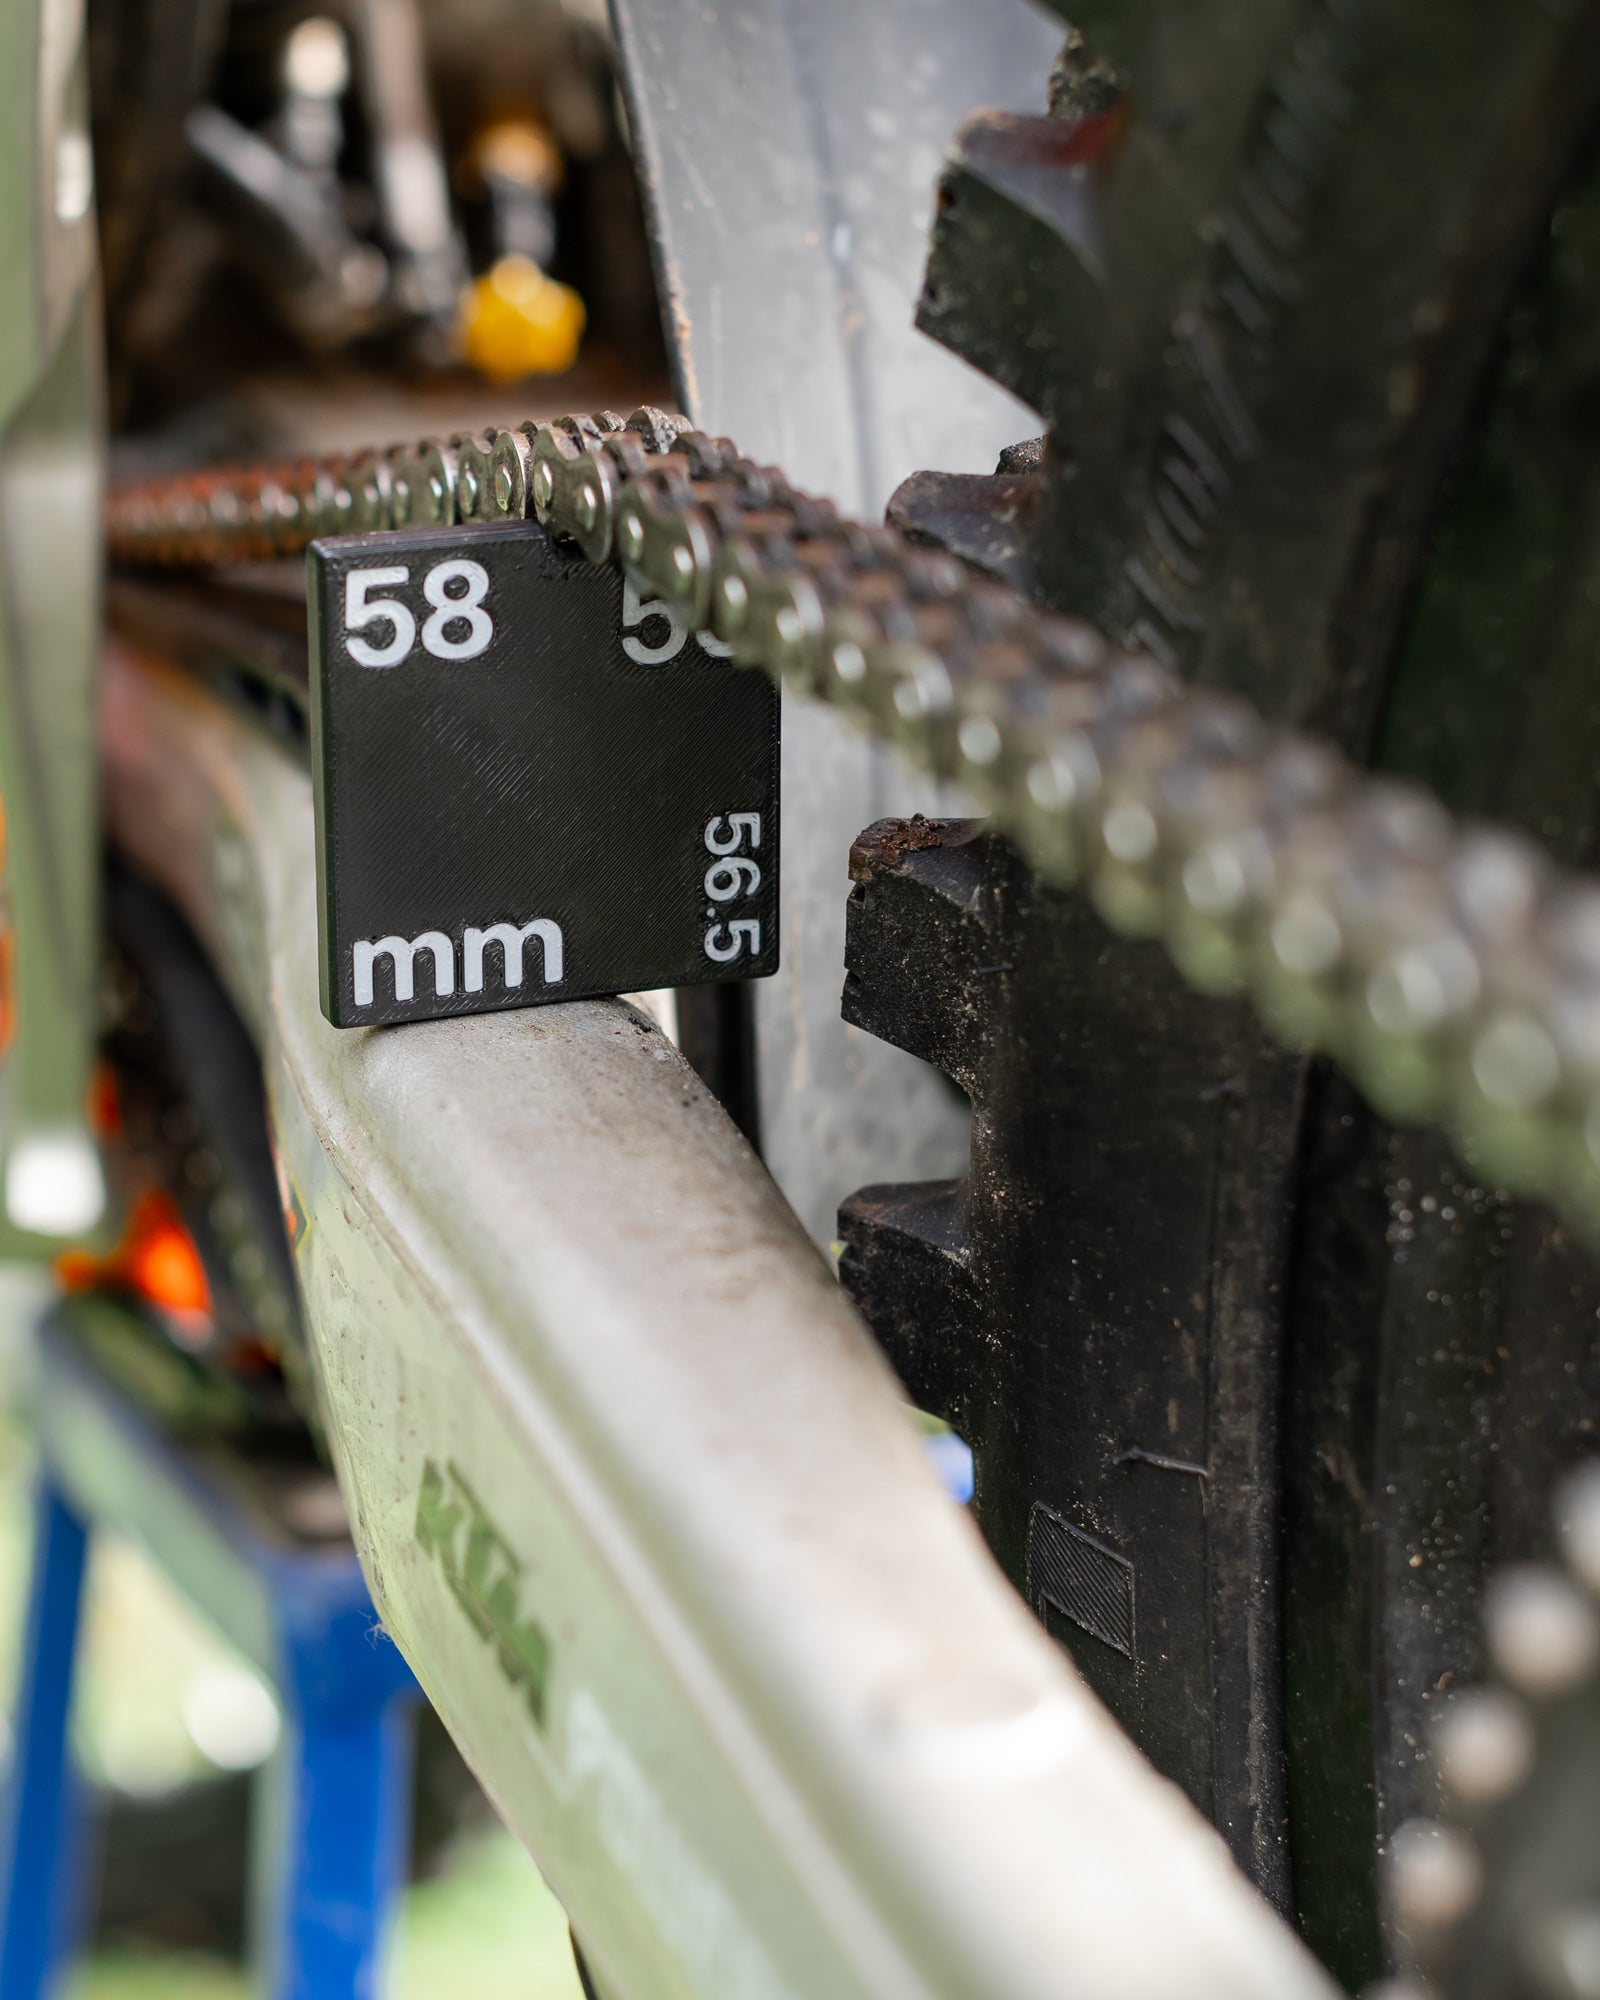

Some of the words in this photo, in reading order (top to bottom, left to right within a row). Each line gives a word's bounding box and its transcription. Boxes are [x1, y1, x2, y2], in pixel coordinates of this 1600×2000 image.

[342, 559, 494, 669] 58
[621, 573, 738, 666] 5
[704, 812, 762, 962] 56.5
[353, 918, 564, 1006] mm
